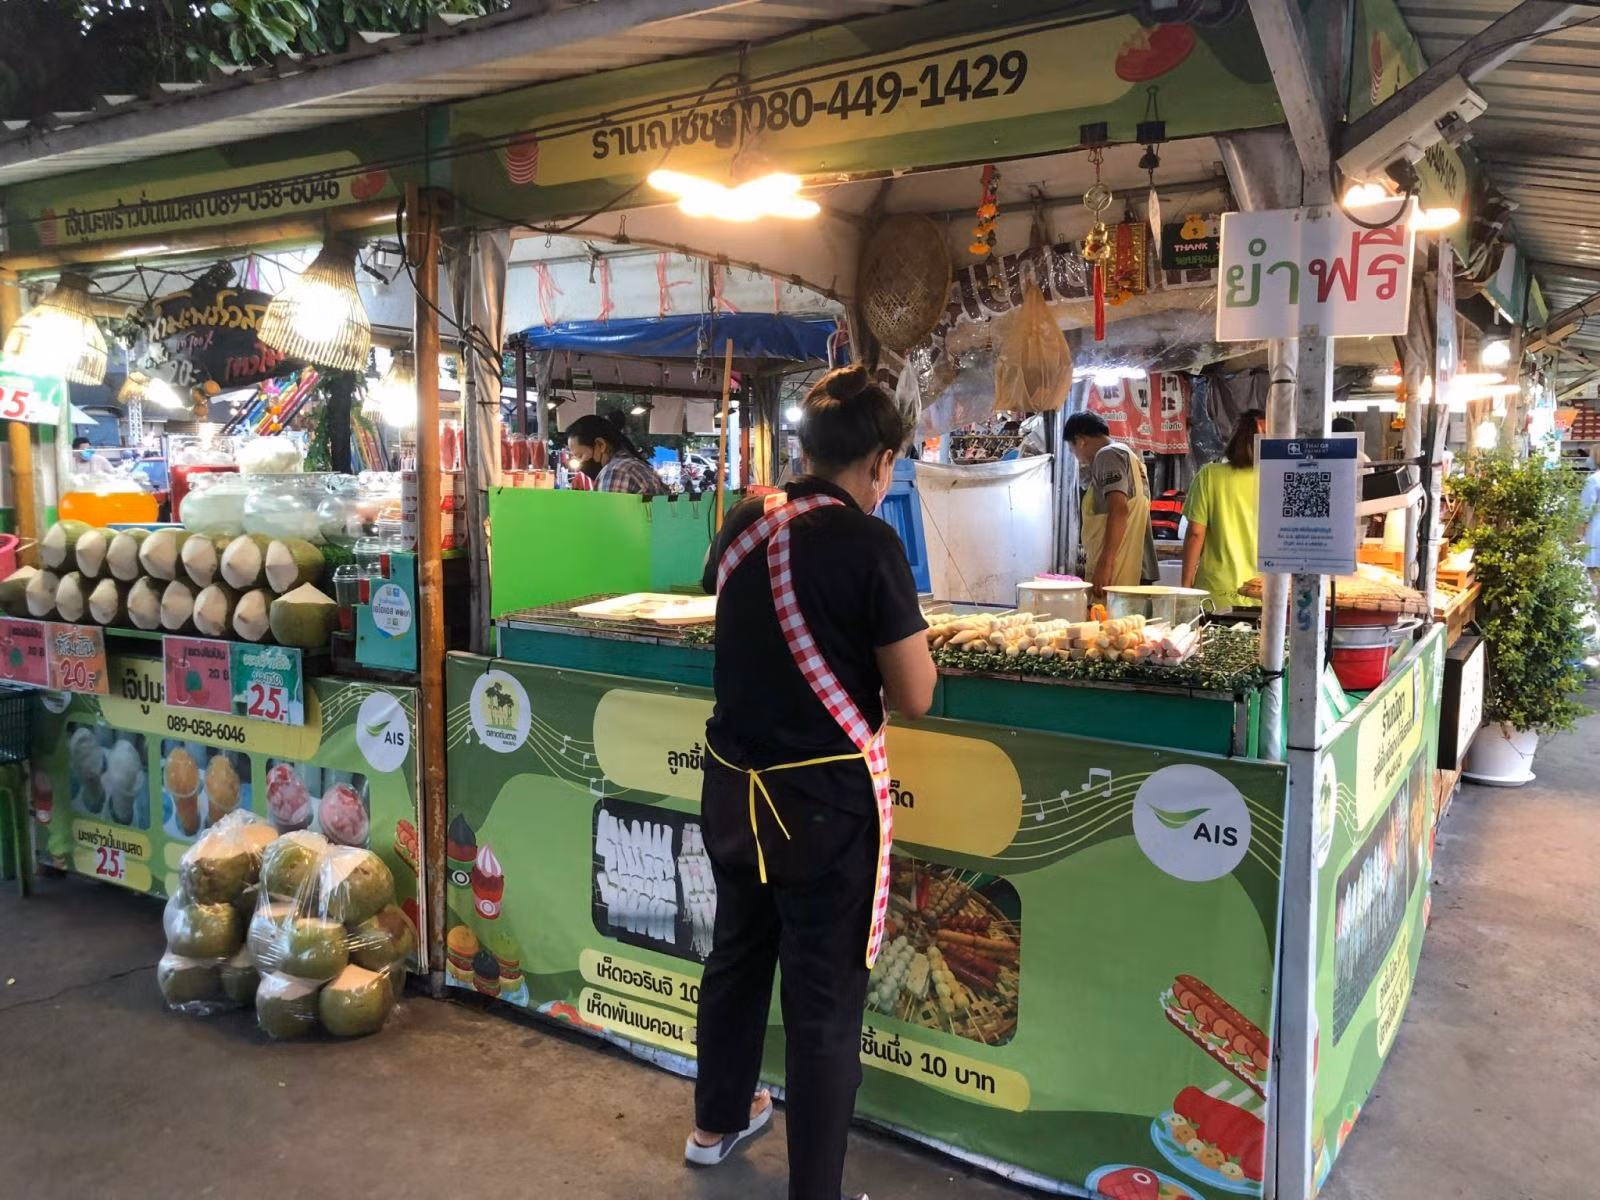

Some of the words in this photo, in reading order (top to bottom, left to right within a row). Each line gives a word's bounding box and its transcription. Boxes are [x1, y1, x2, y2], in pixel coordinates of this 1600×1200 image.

[745, 49, 1028, 133] 080-449-1429
[1174, 242, 1208, 252] THANK
[1225, 224, 1406, 309] ยำฟรี
[167, 714, 246, 744] 089-058-6046
[384, 731, 405, 747] AIS
[1193, 822, 1239, 848] AIS
[597, 955, 673, 997] เห็ดออรินจิ
[586, 992, 684, 1042] เห็ดพันเบคอน
[920, 1052, 948, 1078] 10
[956, 1064, 996, 1095] บาท
